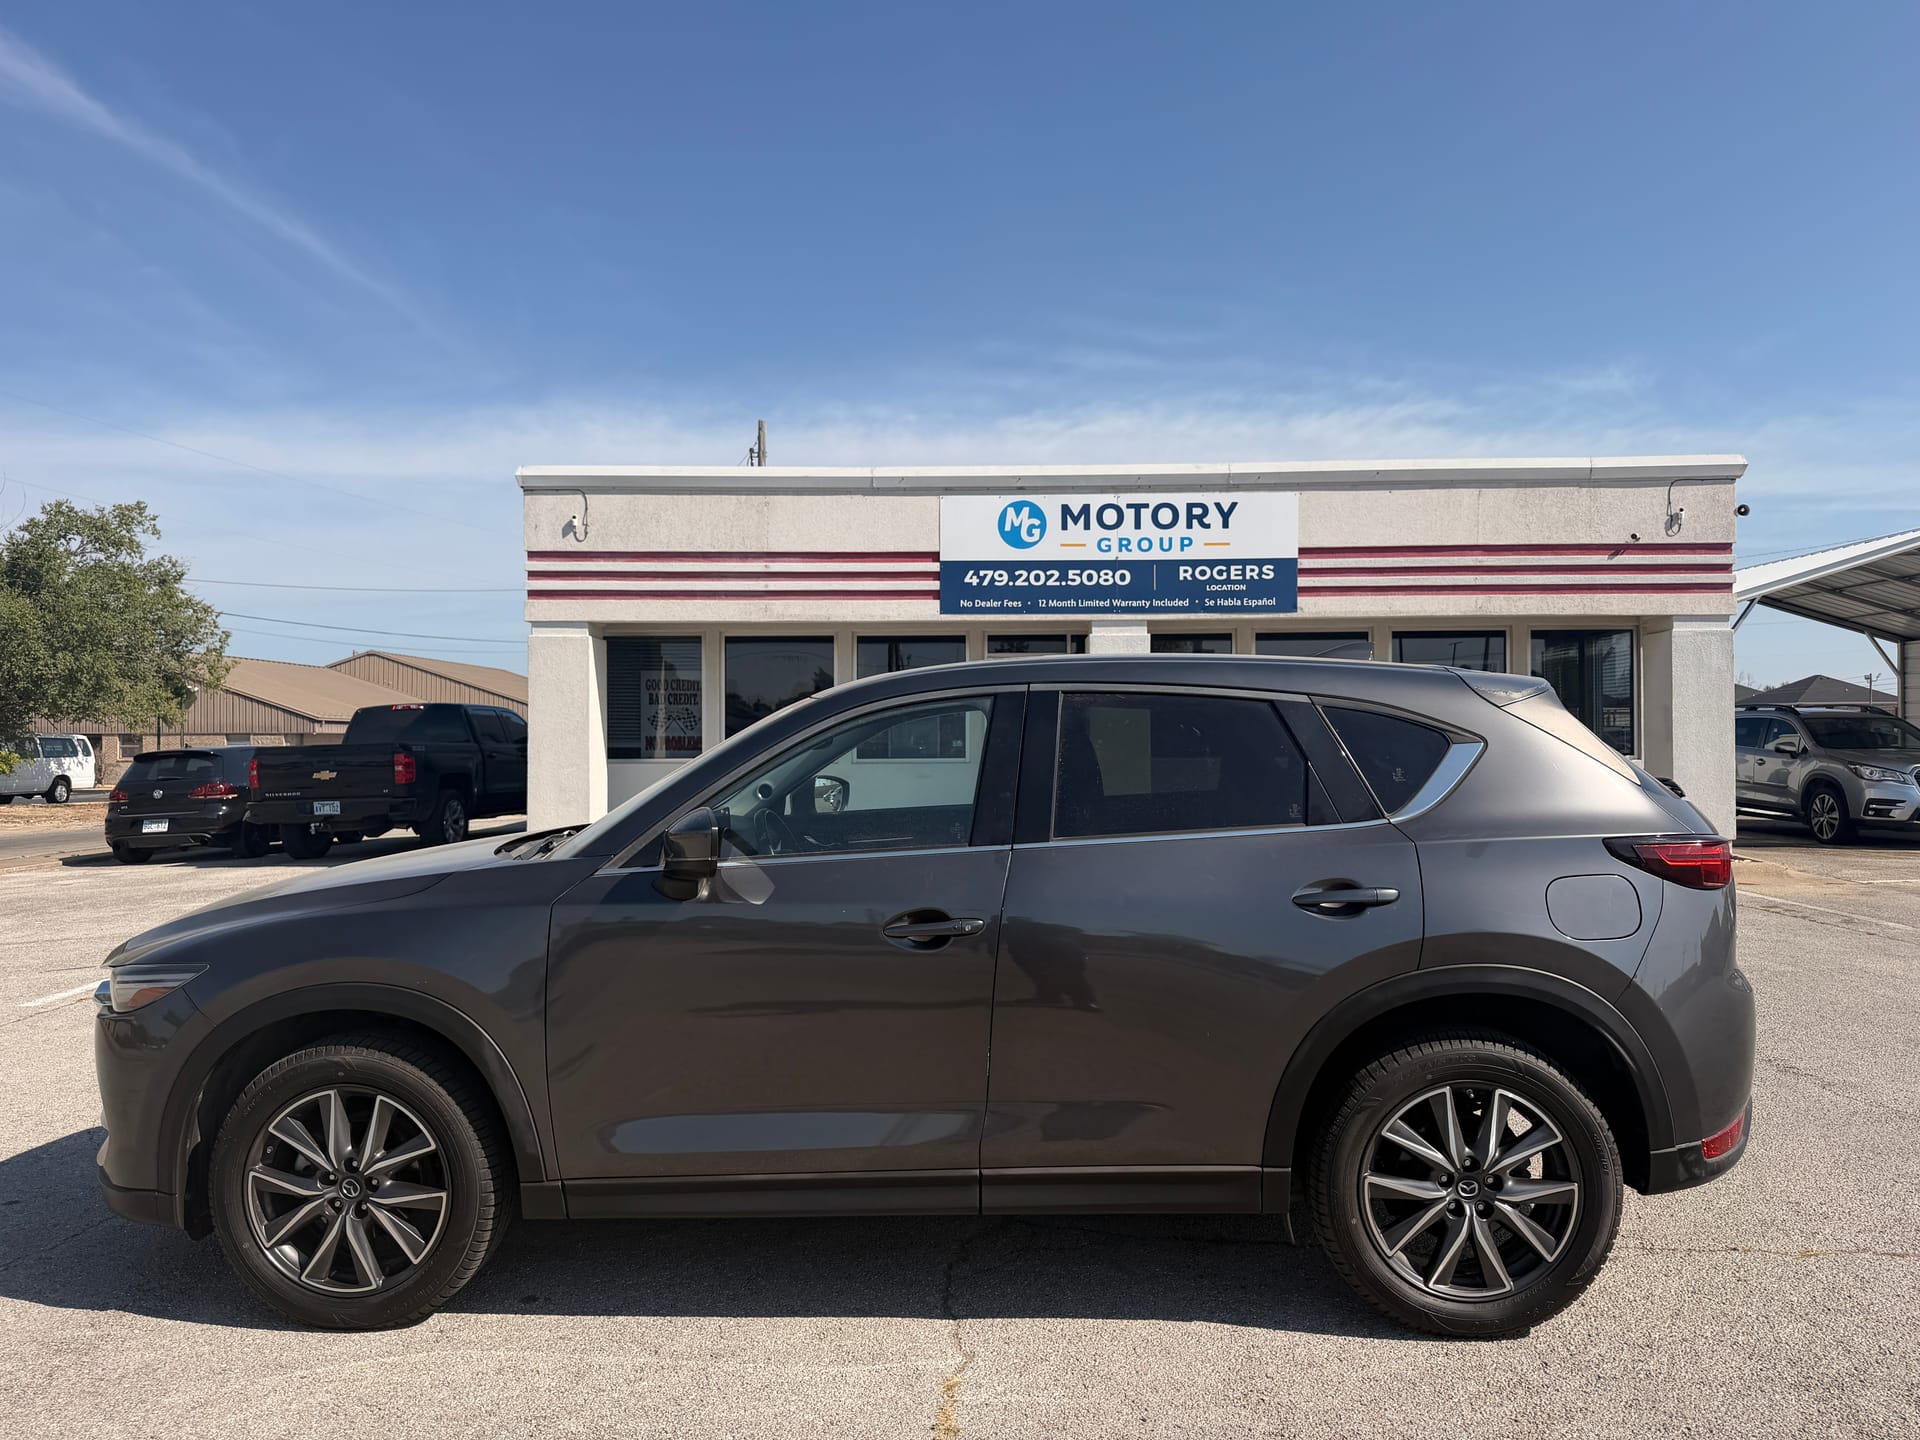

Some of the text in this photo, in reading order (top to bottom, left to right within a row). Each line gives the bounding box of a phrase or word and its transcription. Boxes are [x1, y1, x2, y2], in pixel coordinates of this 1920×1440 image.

[1004, 506, 1041, 543] MG
[1060, 501, 1239, 531] MOTORY
[1096, 536, 1194, 553] GROUP
[963, 569, 1132, 587] 479.202.5080
[1179, 564, 1275, 581] ROGERS
[1206, 584, 1247, 592] LOCATION
[960, 597, 1276, 608] No Dealer Fees 12 Month Limited Warranty Included Se Habla Español
